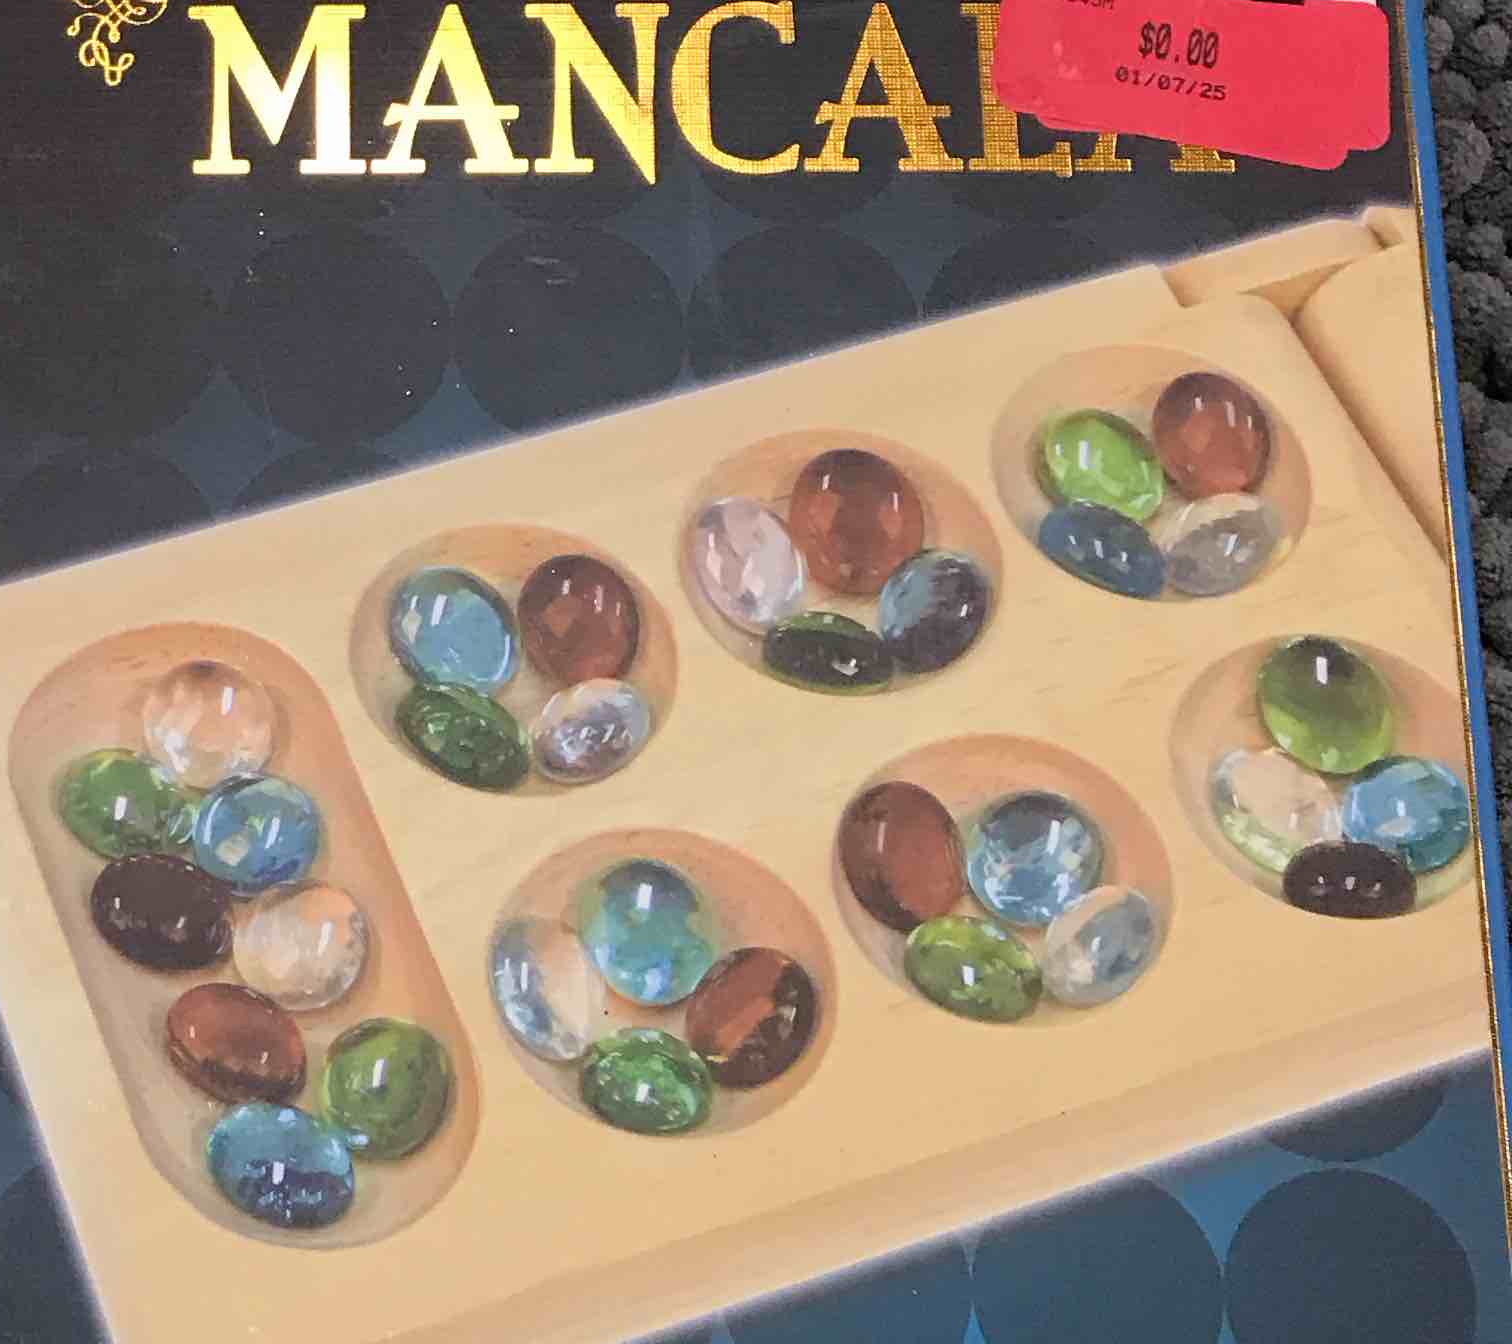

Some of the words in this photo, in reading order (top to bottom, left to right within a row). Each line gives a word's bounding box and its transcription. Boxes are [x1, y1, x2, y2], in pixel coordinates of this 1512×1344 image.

[1139, 21, 1220, 69] $0.00
[187, 0, 1235, 184] MANCAL
[1115, 66, 1227, 101] 01/07/25
